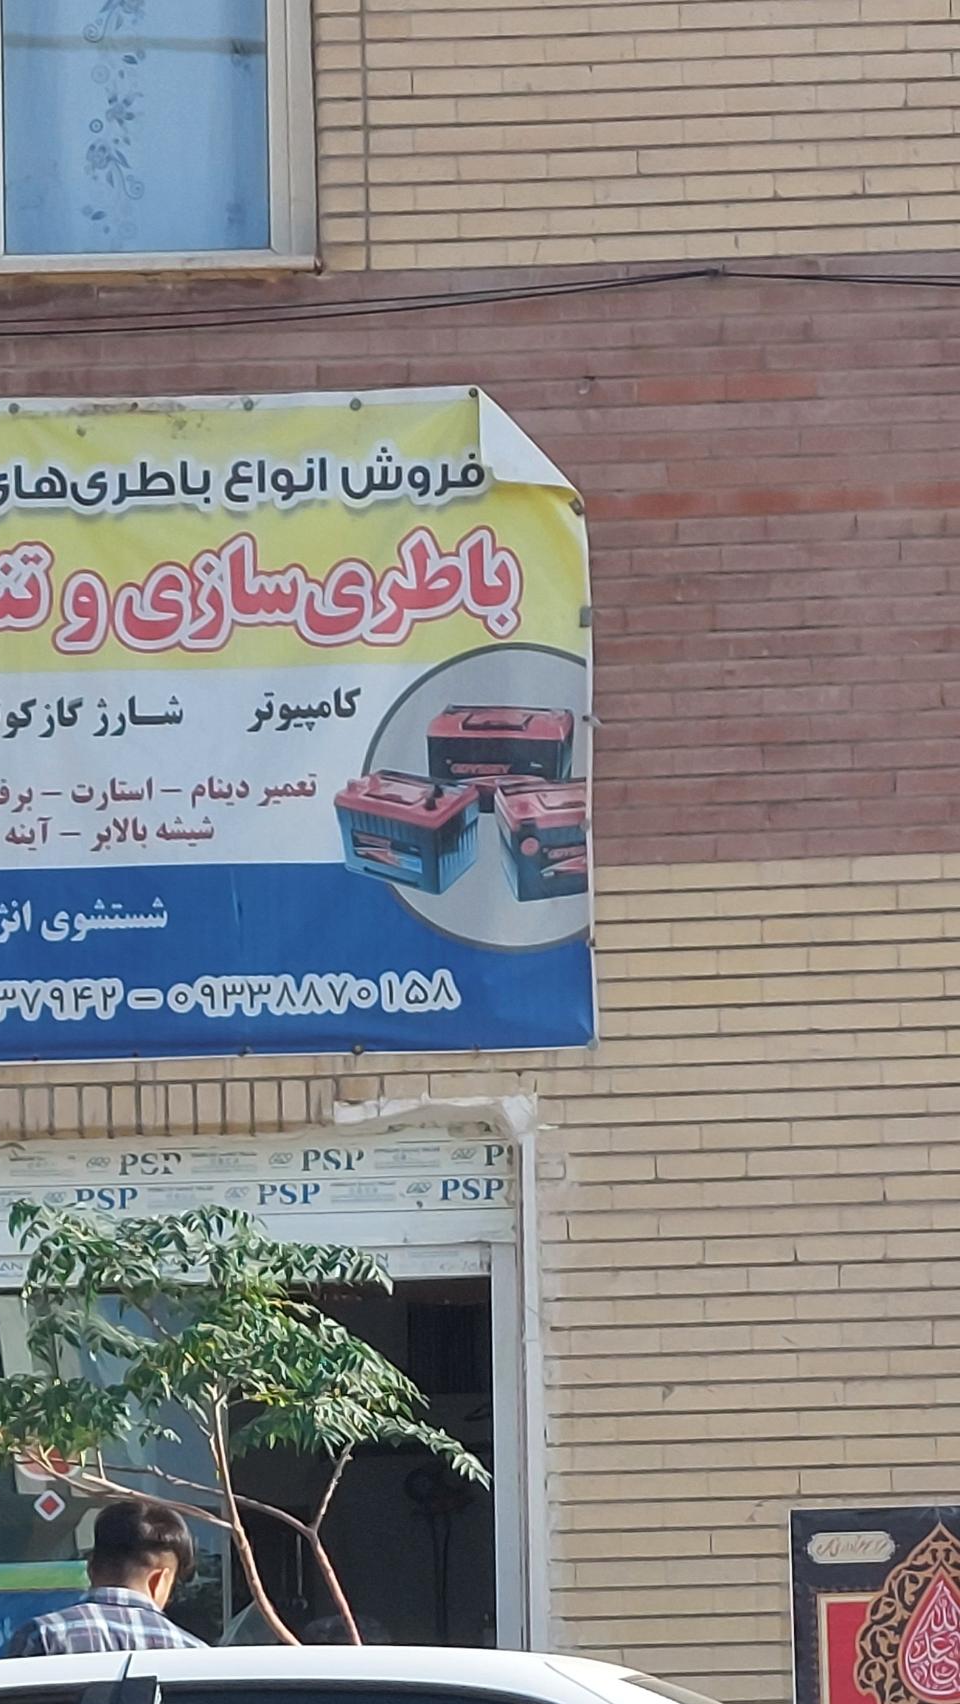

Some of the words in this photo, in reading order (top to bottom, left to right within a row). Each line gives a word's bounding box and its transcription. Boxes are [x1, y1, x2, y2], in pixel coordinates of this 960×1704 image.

[223, 457, 328, 502] انواع
[341, 445, 486, 500] فروش
[53, 569, 111, 654] و
[92, 695, 185, 737] شارژ
[246, 687, 362, 732] کامپیوتر
[70, 775, 155, 809] استارت
[189, 776, 251, 809] دینام
[255, 772, 319, 808] تعمیر
[4, 815, 54, 846] آینه
[88, 818, 150, 853] بالابر
[155, 815, 215, 844] شیشه
[39, 896, 169, 943] شستشوی
[301, 1148, 365, 1172] PSP
[75, 1186, 139, 1211] PSP
[257, 1182, 321, 1206] PSP
[440, 1177, 505, 1201] PSP
